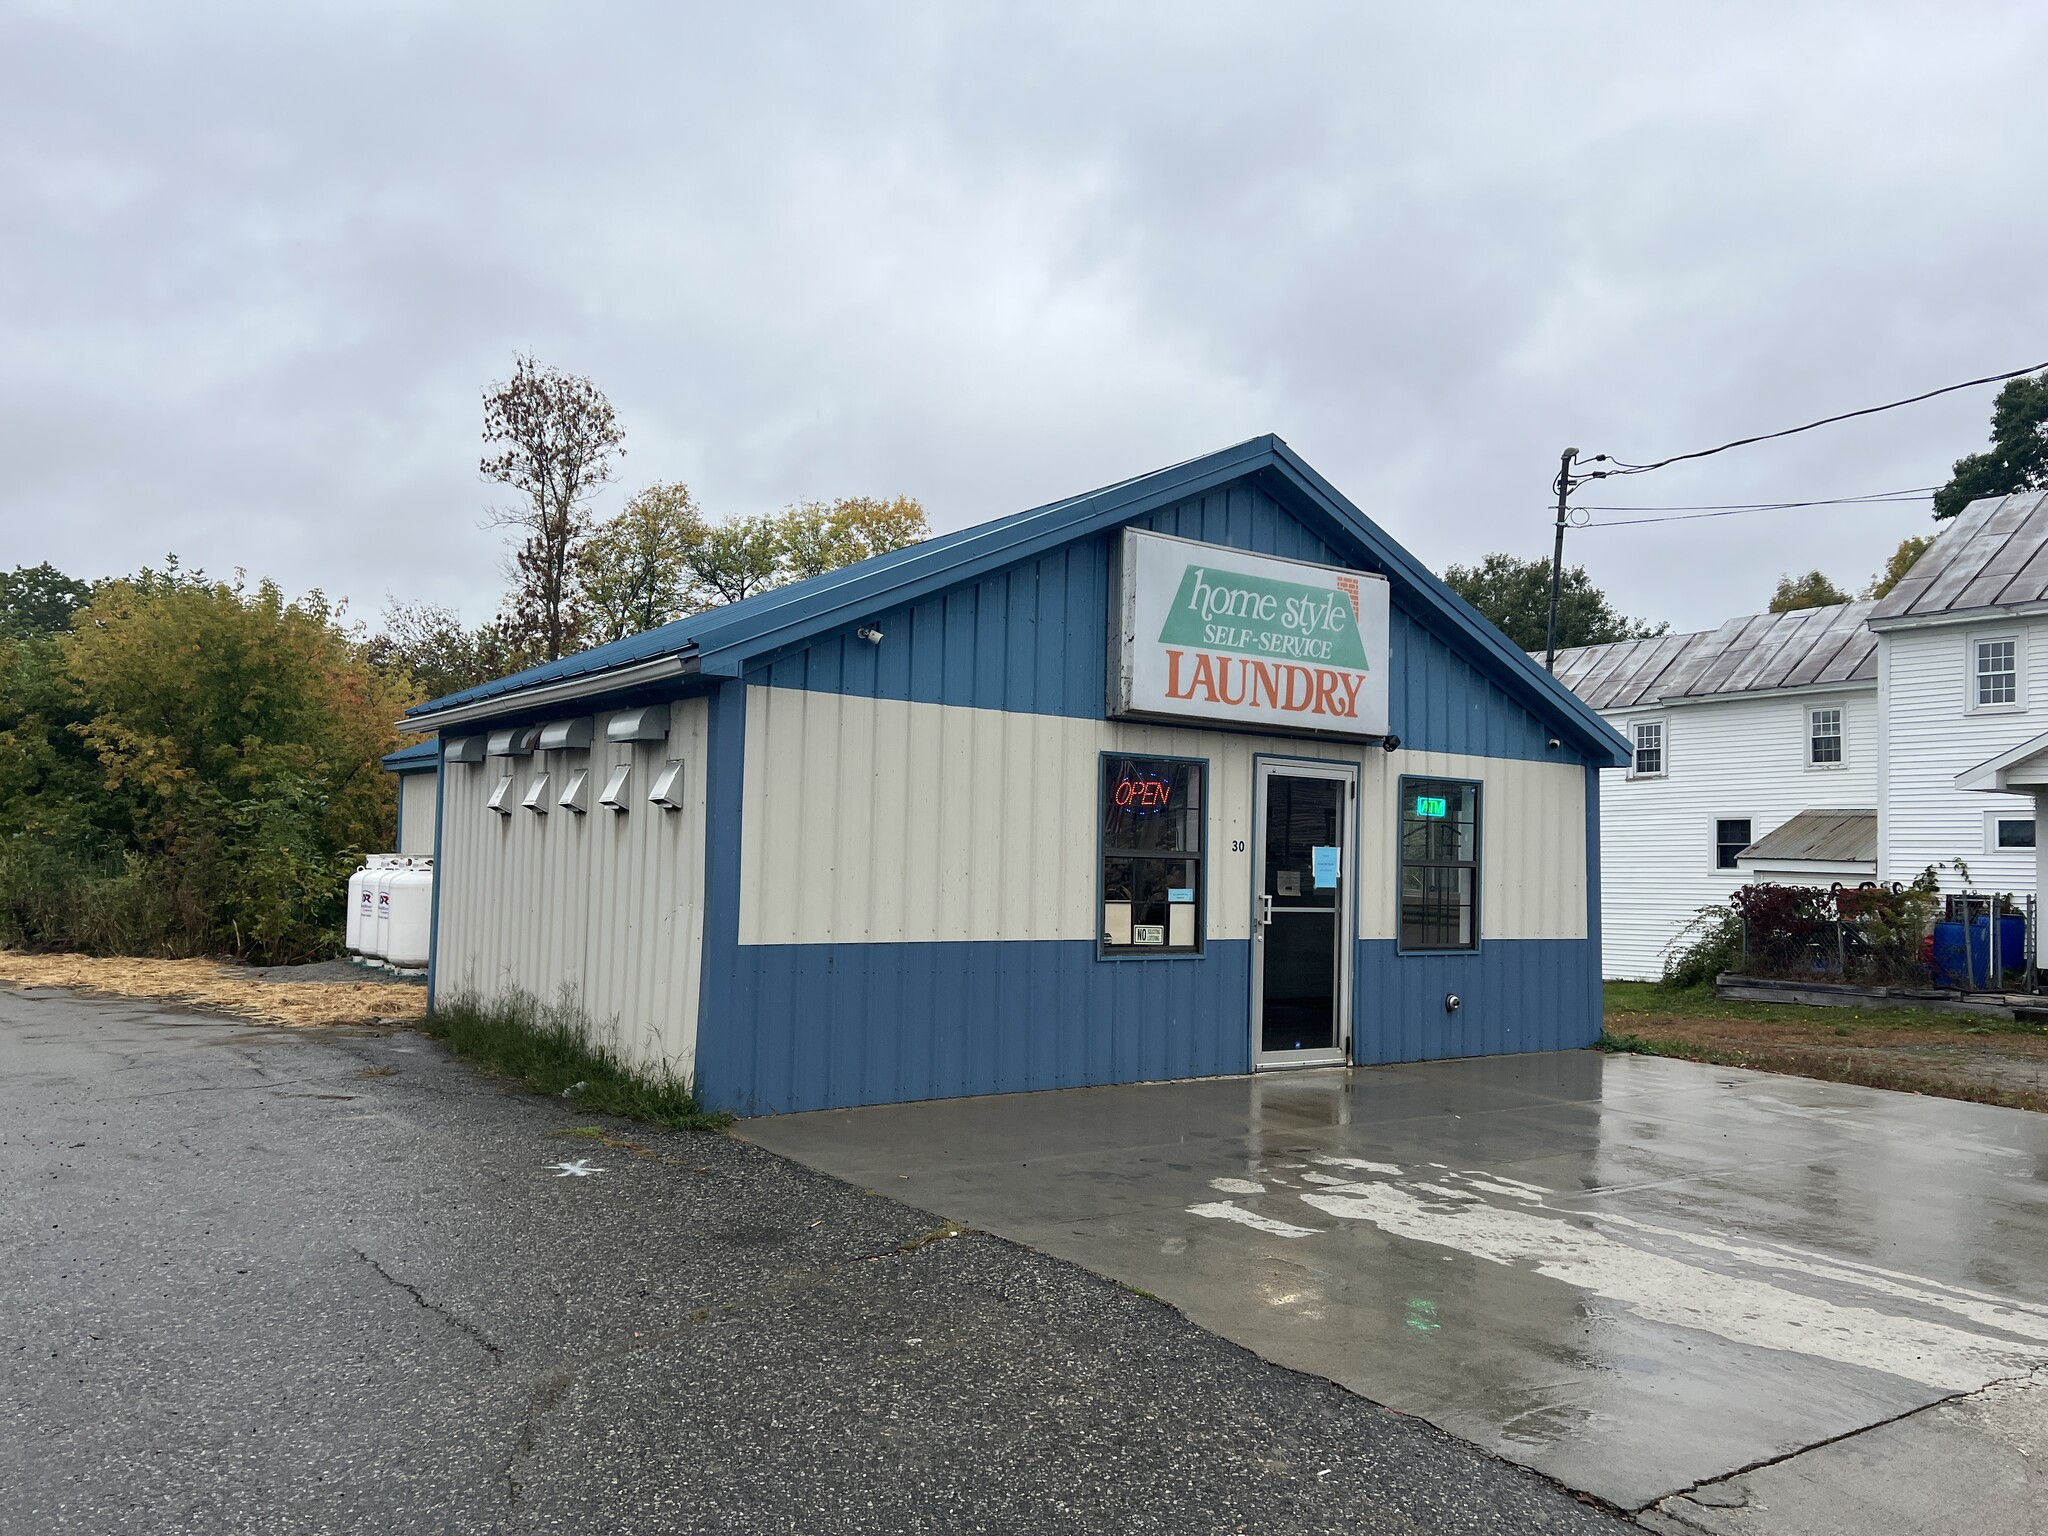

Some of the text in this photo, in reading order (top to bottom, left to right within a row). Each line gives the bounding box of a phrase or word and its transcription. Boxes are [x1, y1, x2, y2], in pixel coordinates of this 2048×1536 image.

[1188, 568, 1346, 635] home style
[1203, 623, 1333, 659] SELF-SERVICE
[1165, 649, 1366, 718] LAUNDRY
[1115, 781, 1170, 805] OPEN
[1421, 799, 1444, 815] ATM
[1231, 840, 1245, 852] 30
[1137, 928, 1147, 941] NO
